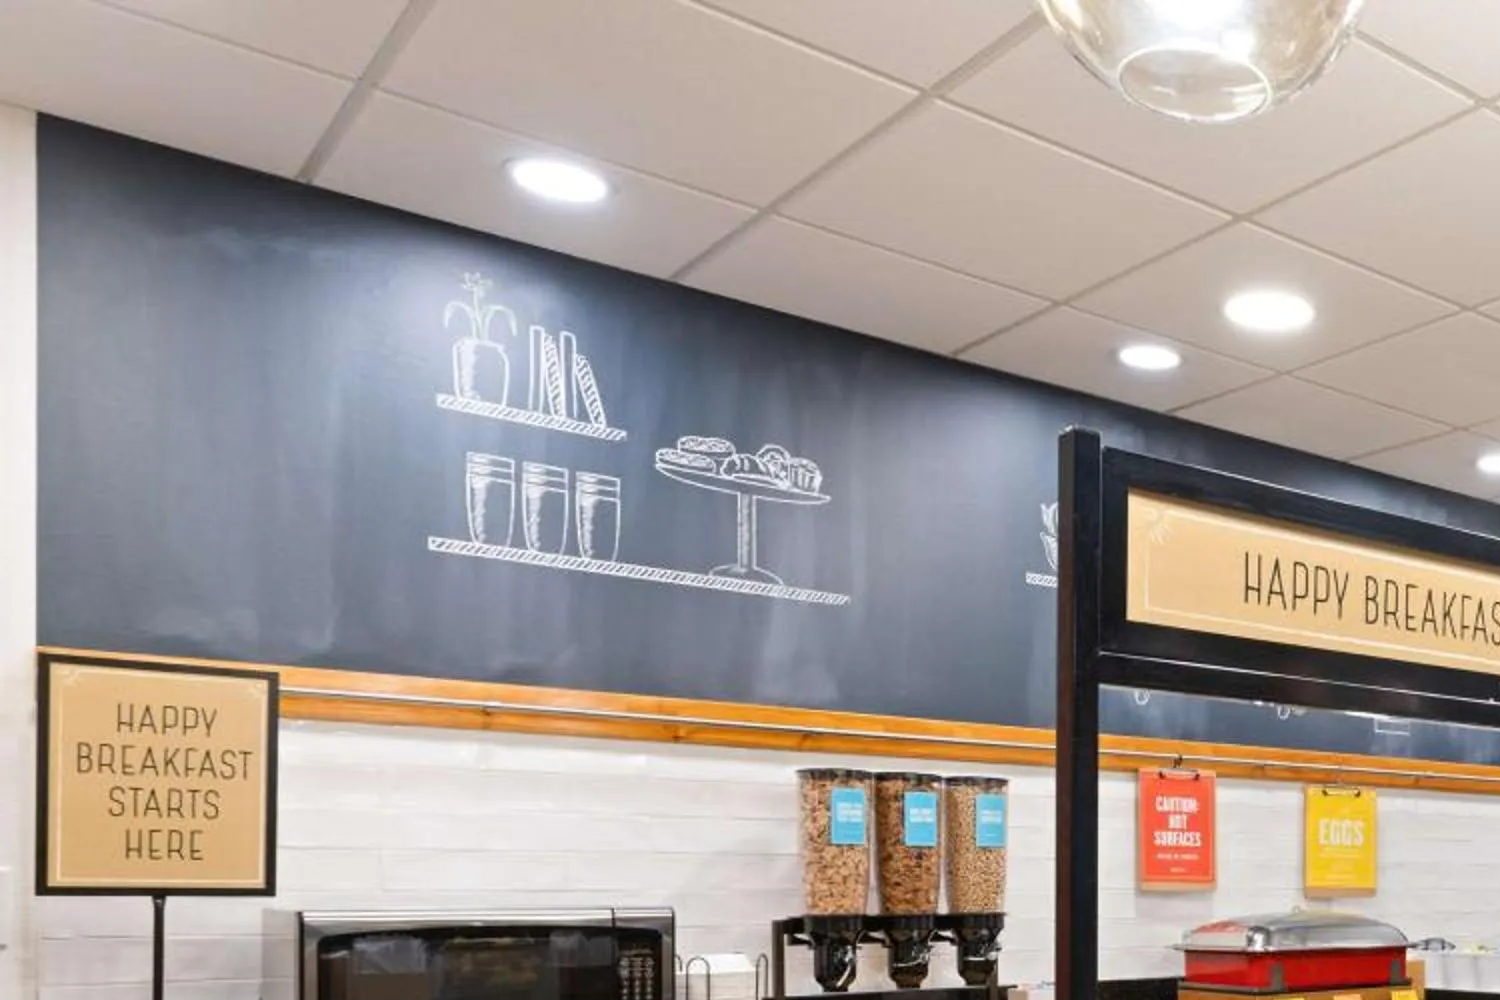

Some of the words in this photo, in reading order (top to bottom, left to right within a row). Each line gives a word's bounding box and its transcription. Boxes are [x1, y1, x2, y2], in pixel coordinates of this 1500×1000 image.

[1244, 551, 1349, 620] HAPPY
[117, 703, 217, 737] HAPPY
[76, 741, 254, 780] BREAKFAST
[108, 786, 221, 820] STARTS
[125, 829, 204, 861] HERE
[1153, 831, 1202, 847] SURFACES
[1318, 818, 1364, 847] EGGS
